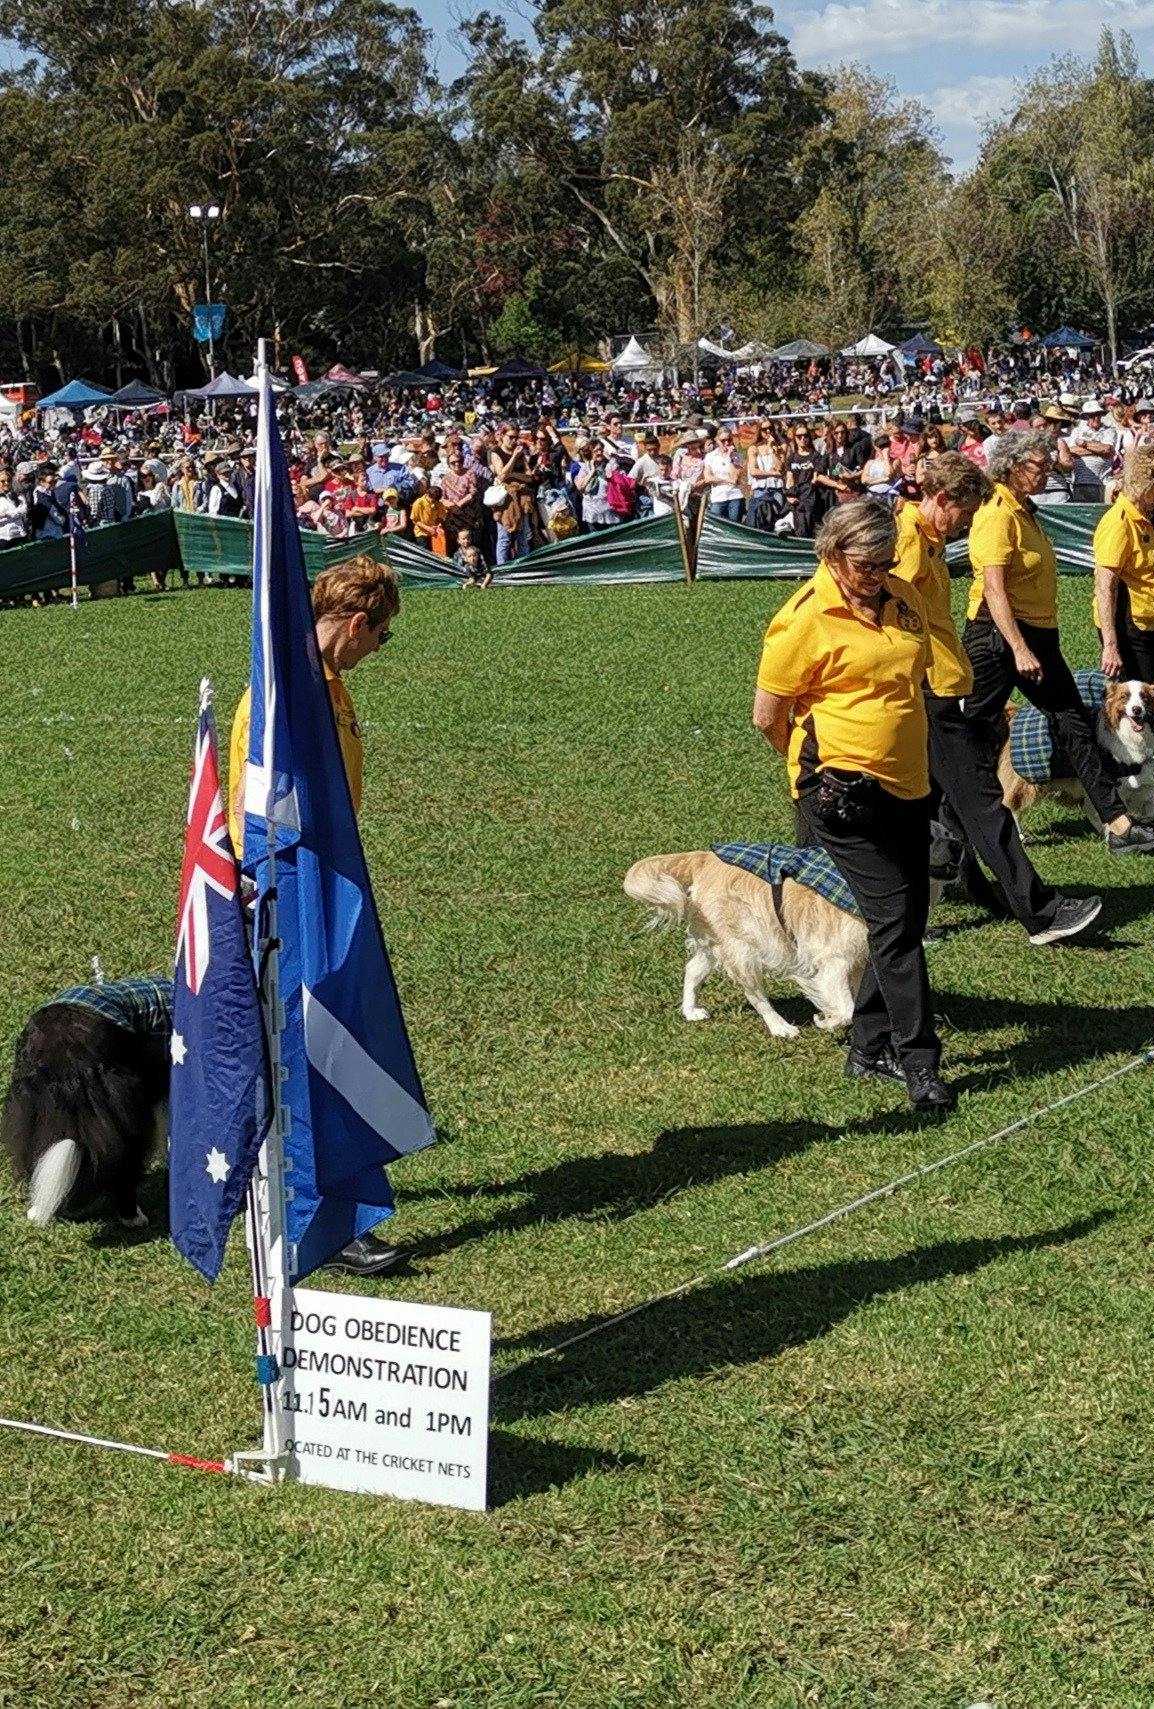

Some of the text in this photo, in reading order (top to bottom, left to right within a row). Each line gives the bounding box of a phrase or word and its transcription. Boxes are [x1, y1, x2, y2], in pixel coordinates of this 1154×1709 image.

[291, 1310, 461, 1352] DOG OBEDIENCE
[283, 1346, 468, 1392] DEMONSTRATION
[283, 1387, 472, 1436] 11.15AM and 1PM
[285, 1439, 472, 1479] OCATED AT THE CRICKET NETS
